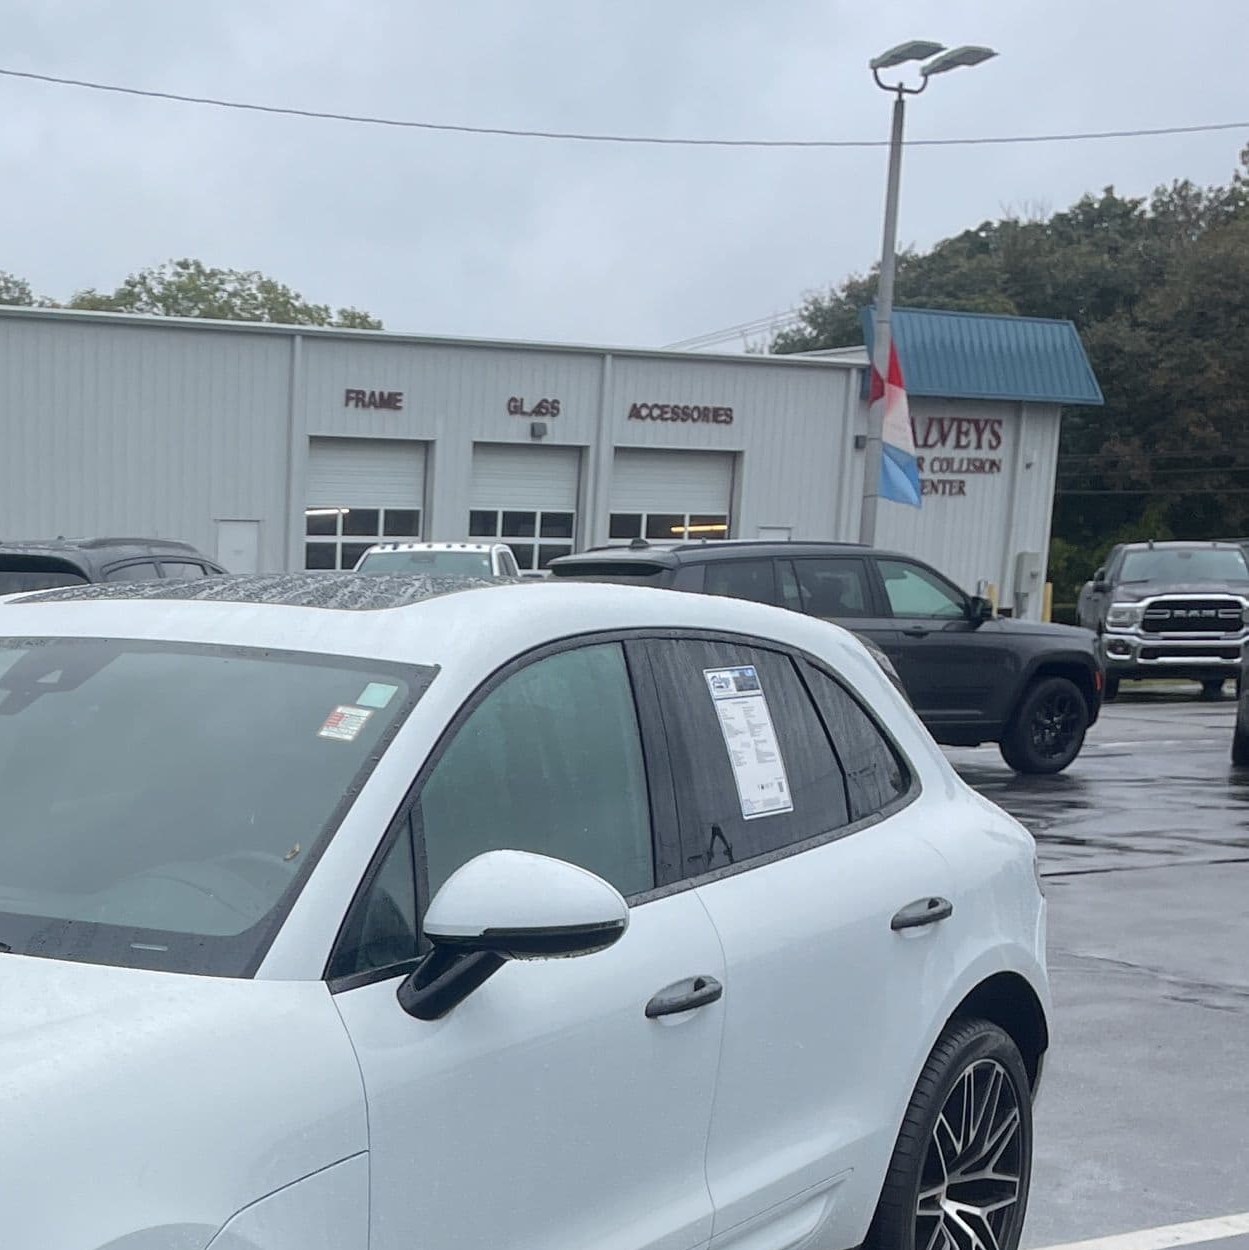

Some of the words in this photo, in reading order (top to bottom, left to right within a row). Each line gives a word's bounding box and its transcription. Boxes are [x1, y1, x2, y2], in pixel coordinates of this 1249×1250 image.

[344, 388, 404, 410] FRAME
[507, 396, 561, 418] GLASS
[627, 402, 734, 424] ACCESSORIES
[918, 478, 966, 496] ENTER
[1173, 609, 1216, 618] RAM
